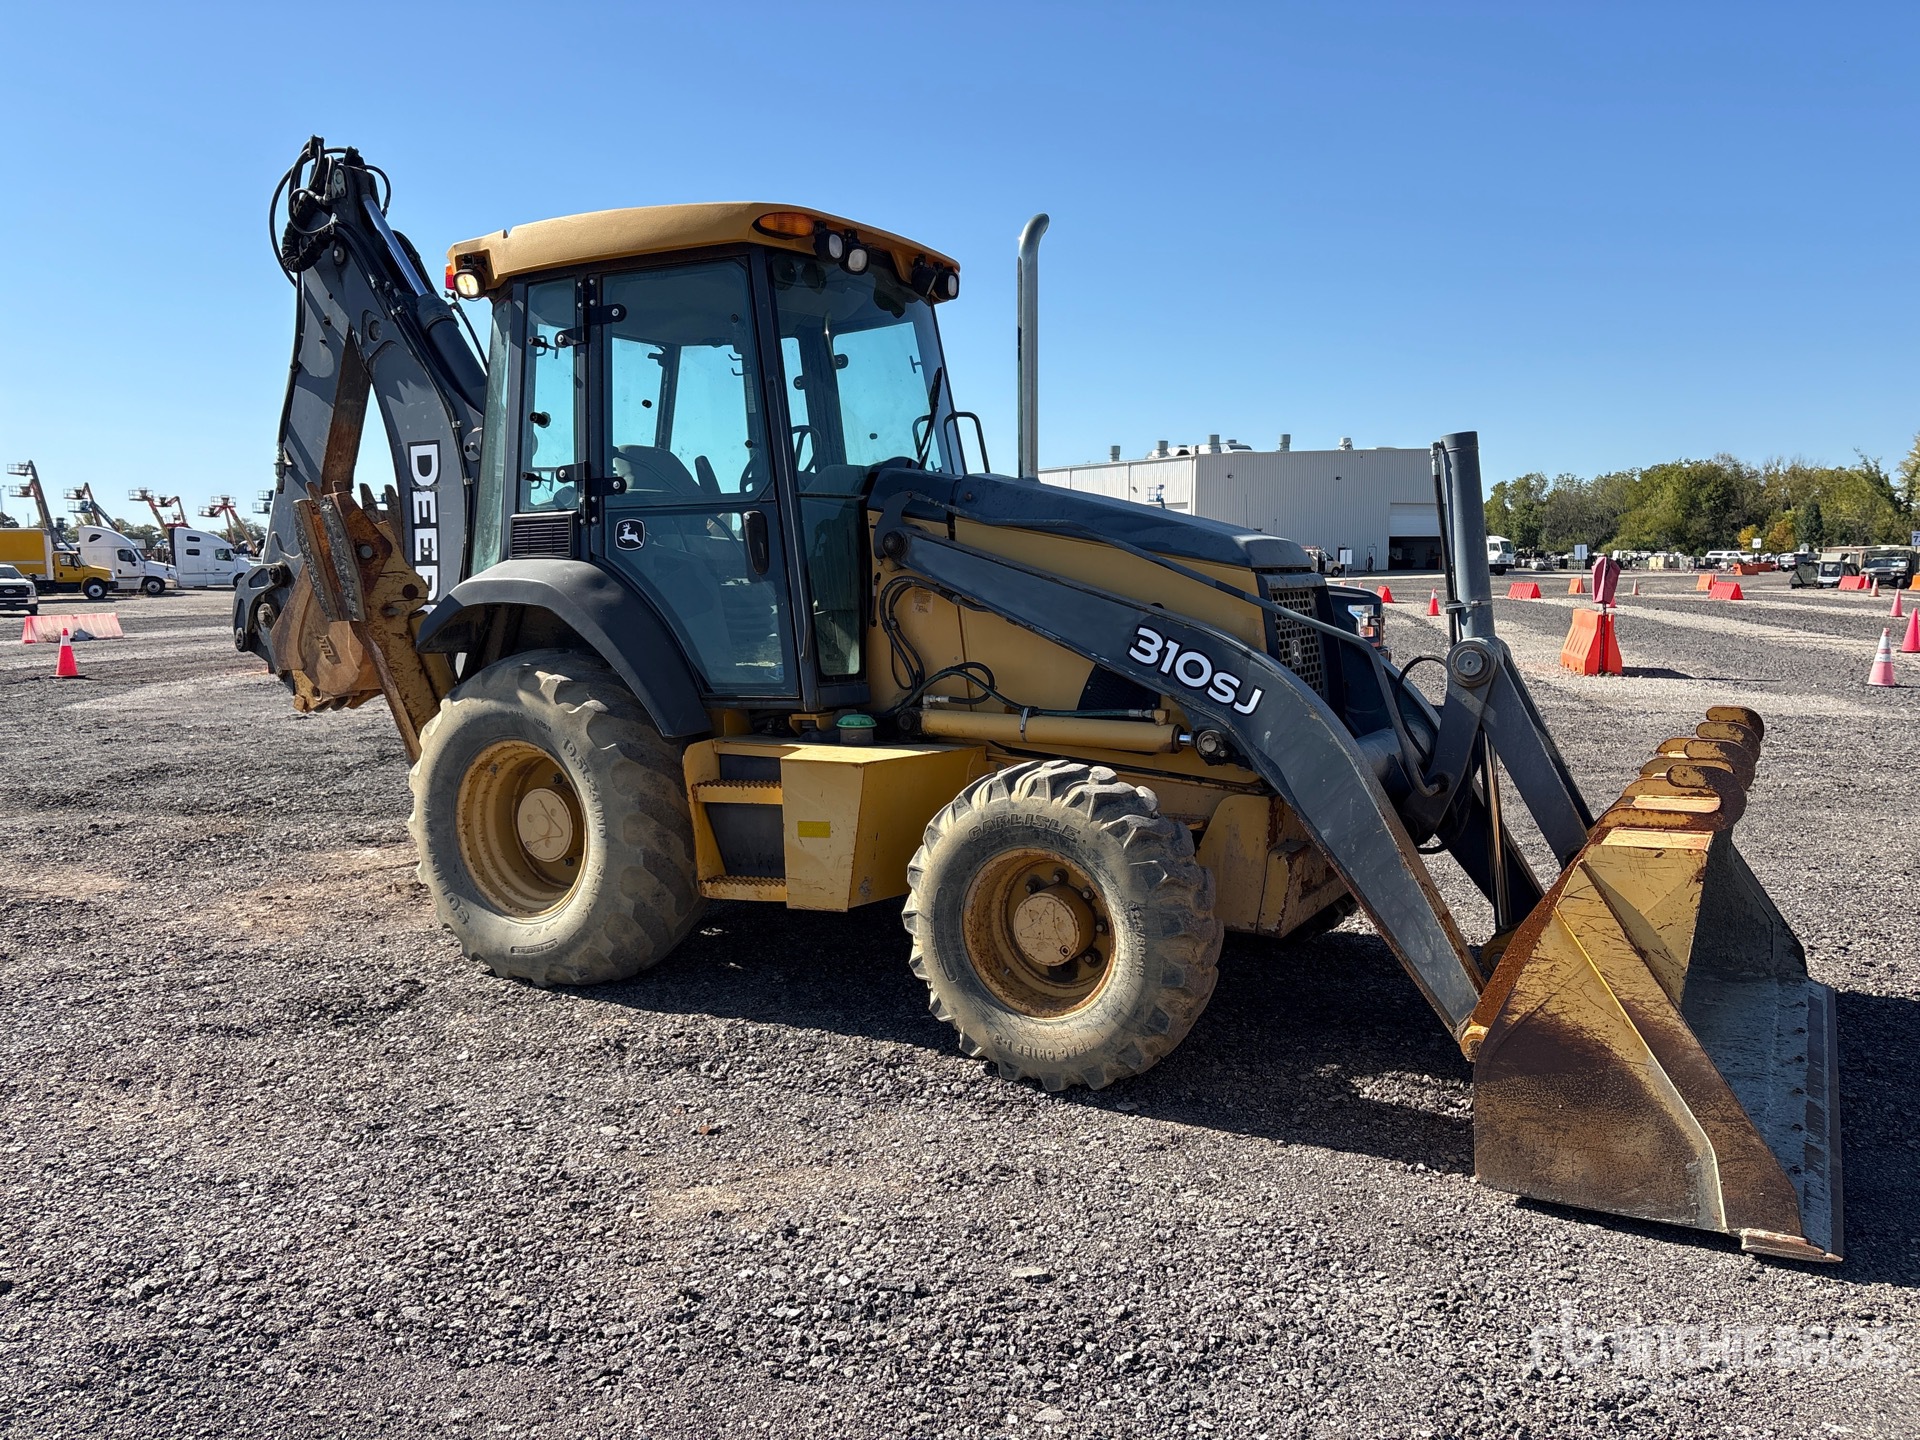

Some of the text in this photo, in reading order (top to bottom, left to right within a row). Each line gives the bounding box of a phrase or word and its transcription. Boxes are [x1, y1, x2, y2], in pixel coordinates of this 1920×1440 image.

[410, 444, 438, 614] DEER
[1129, 627, 1262, 715] 310SJ
[968, 813, 1081, 843] CARLISLE
